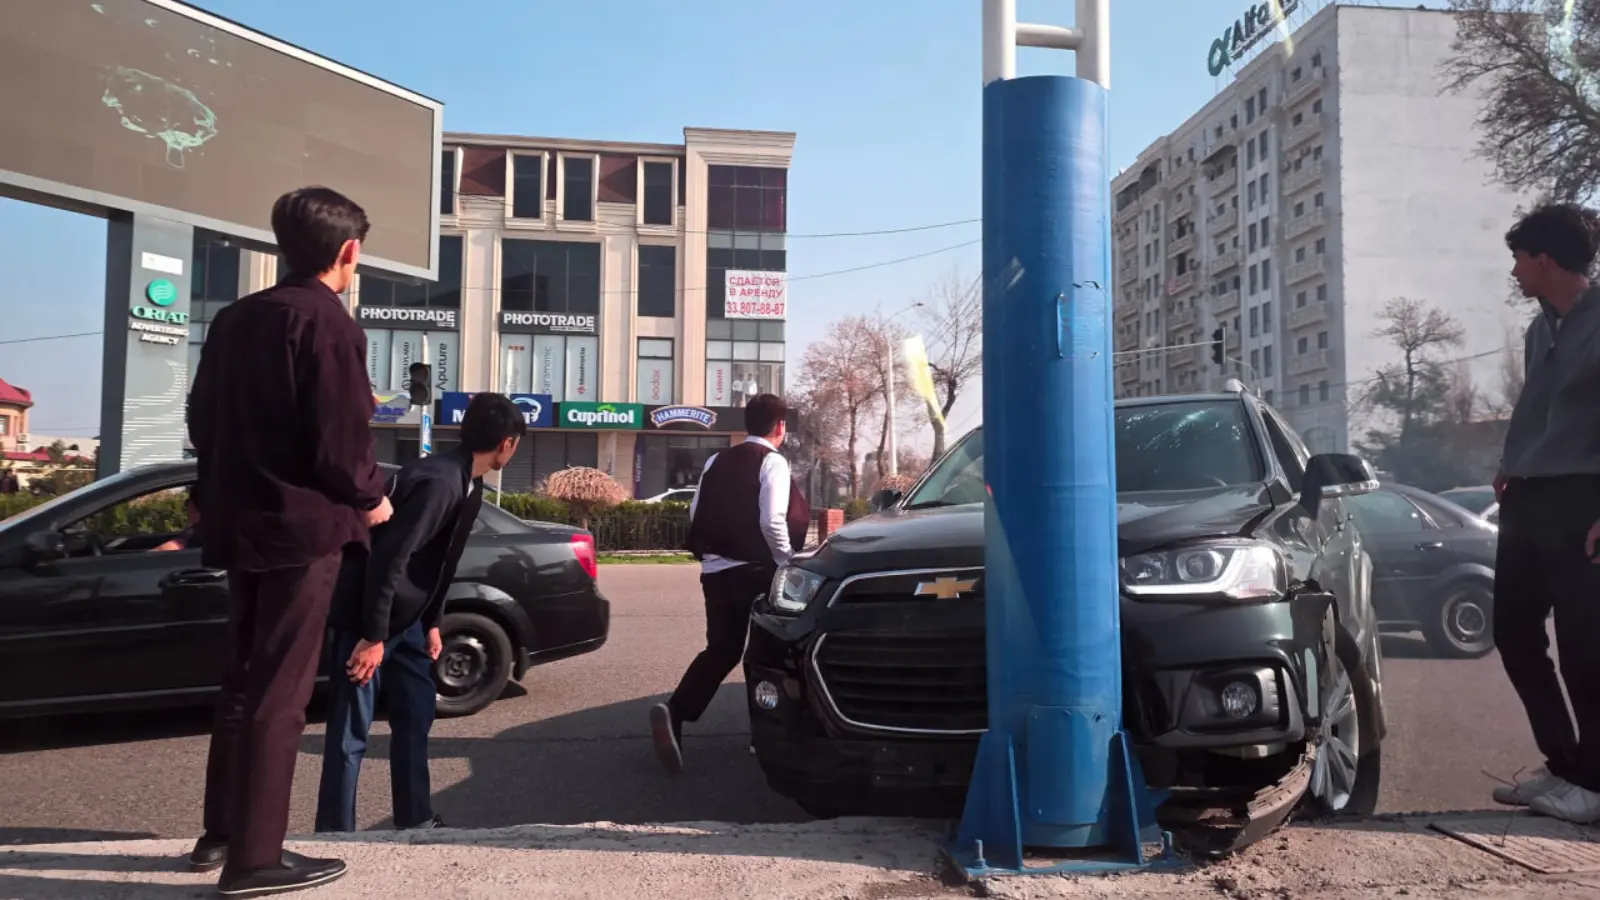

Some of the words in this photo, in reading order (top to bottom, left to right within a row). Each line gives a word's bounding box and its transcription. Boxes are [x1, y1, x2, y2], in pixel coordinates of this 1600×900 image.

[729, 288, 736, 296] В
[740, 288, 783, 298] АРЕНДУ
[360, 307, 455, 322] PHOTOTRADE
[503, 313, 595, 327] PHOTOTRADE
[130, 321, 189, 336] ADVERTISING
[140, 333, 179, 345] AGENCY
[435, 342, 449, 391] Aputure
[567, 408, 635, 426] Cuprinol
[656, 408, 711, 424] HAMMERITE
